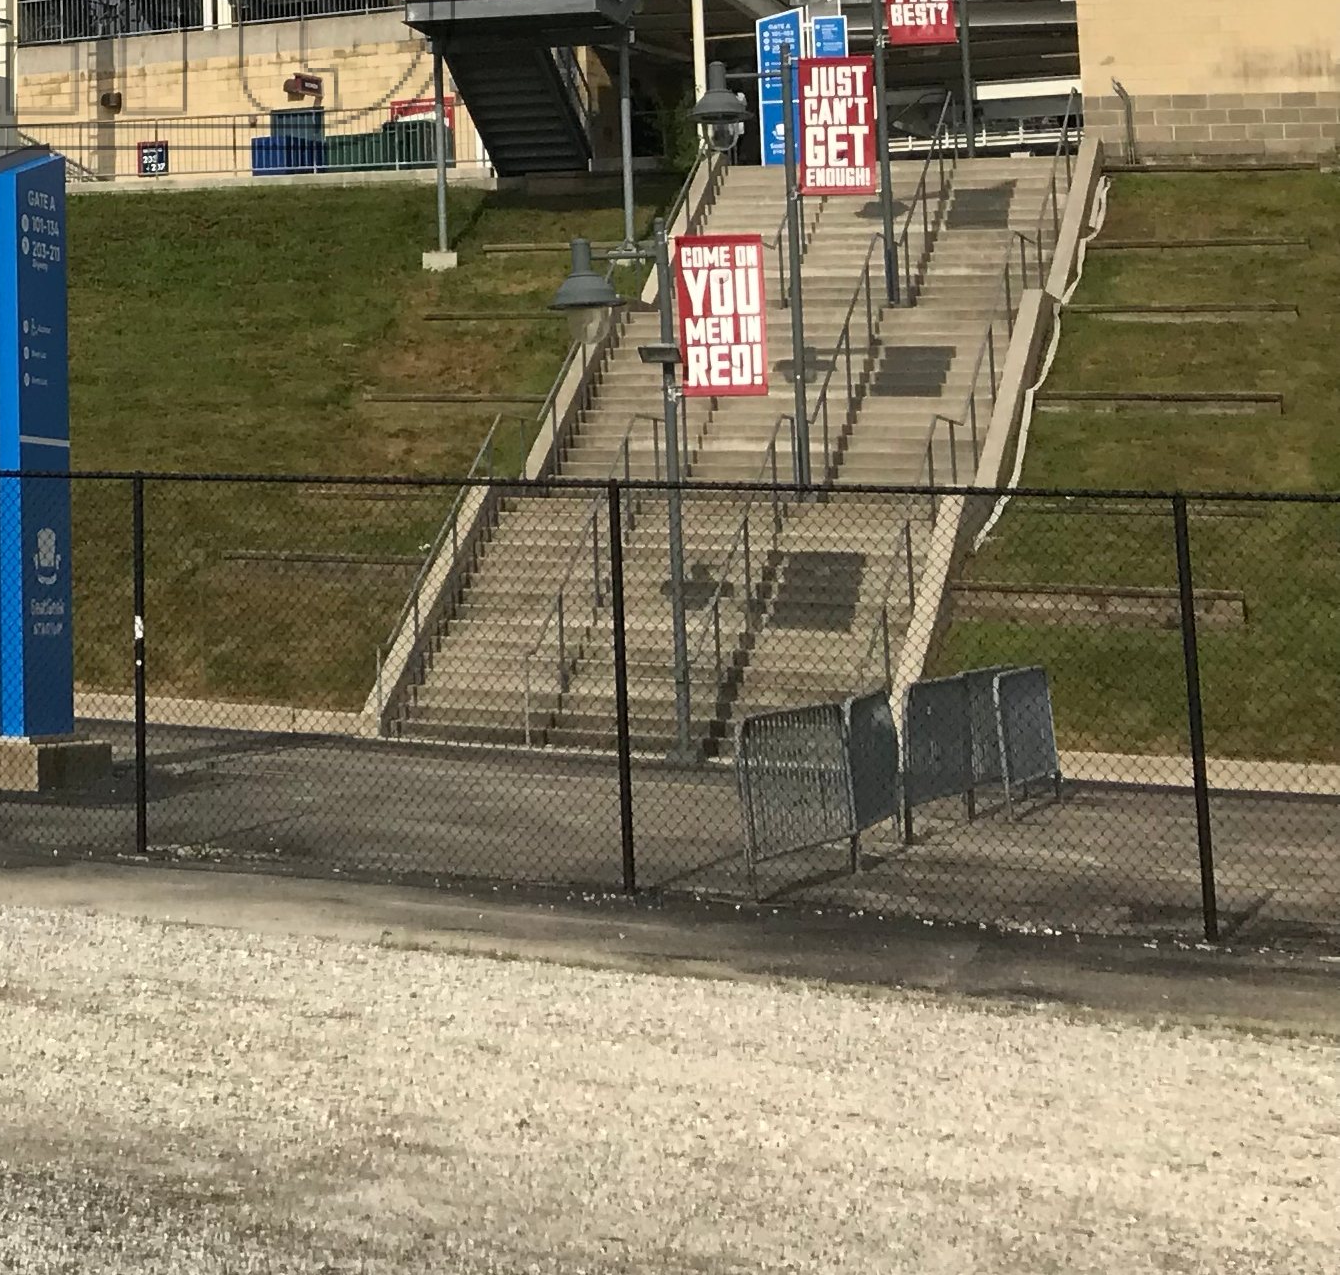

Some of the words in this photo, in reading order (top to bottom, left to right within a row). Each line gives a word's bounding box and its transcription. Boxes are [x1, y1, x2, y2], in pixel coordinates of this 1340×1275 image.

[890, 4, 948, 26] BEST?
[804, 65, 867, 97] JUST
[804, 97, 867, 126] CAN'T
[805, 125, 869, 167] GET
[805, 167, 871, 187] ENOUGH!
[27, 190, 49, 210] GATE
[49, 196, 56, 211] A
[681, 246, 731, 268] COME
[734, 245, 758, 267] ON
[682, 267, 761, 316] YOU
[685, 316, 735, 345] MEN
[740, 316, 762, 343] IN
[687, 344, 764, 387] RED!
